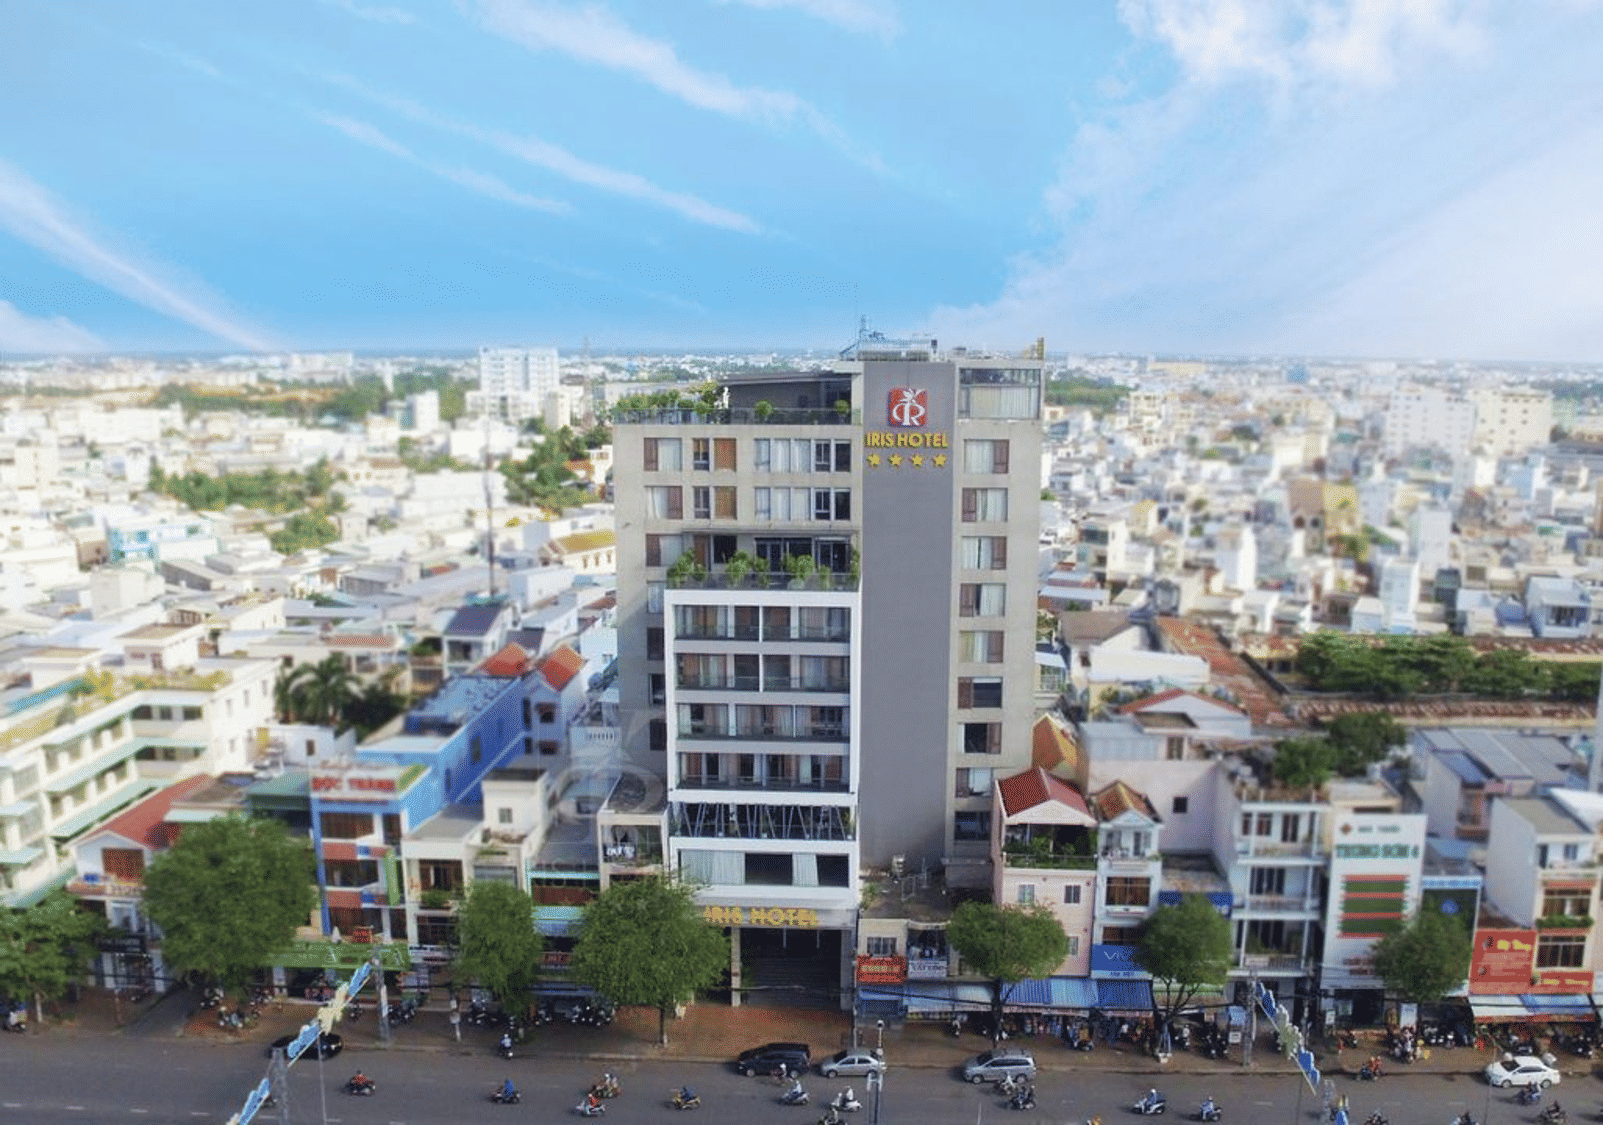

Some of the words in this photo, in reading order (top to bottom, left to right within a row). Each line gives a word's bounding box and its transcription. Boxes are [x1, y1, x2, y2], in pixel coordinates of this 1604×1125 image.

[865, 432, 895, 447] IRIS
[897, 433, 948, 447] HOTEL
[749, 907, 818, 926] HOTEL
